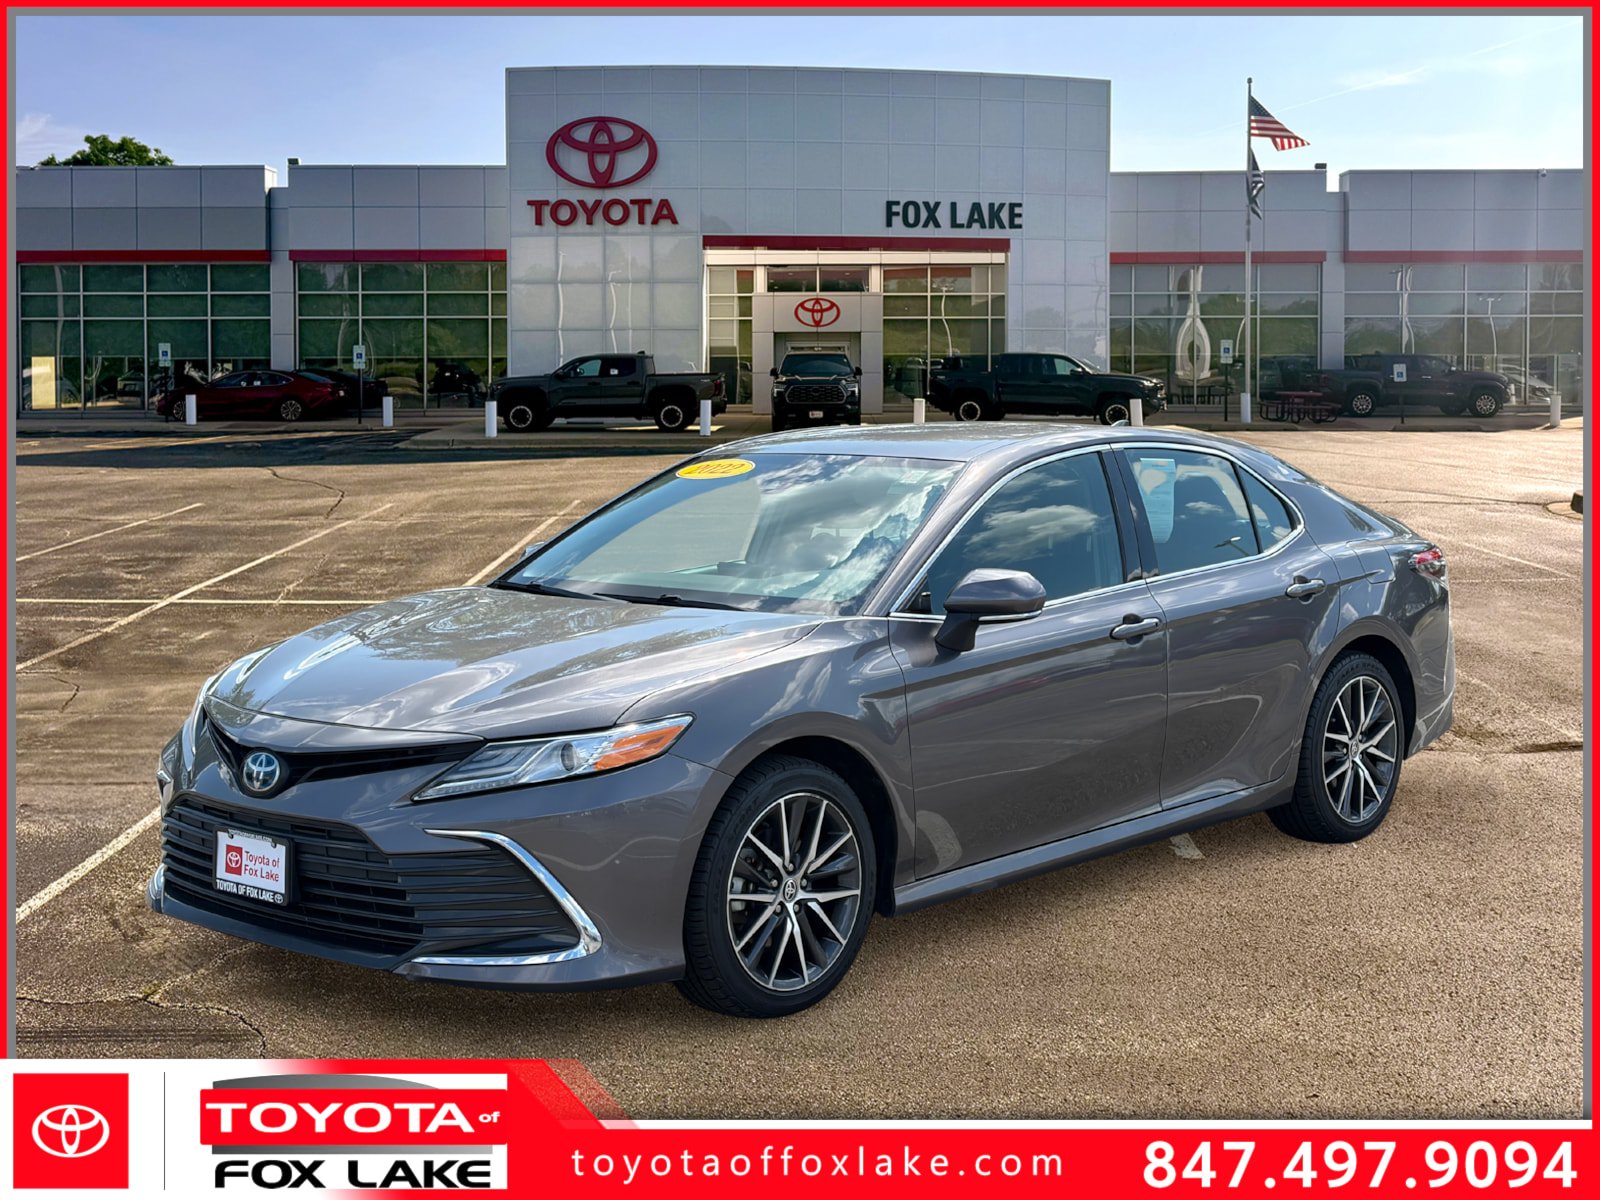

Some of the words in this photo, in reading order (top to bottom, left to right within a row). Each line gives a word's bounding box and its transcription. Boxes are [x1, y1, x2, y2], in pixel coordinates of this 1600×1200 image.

[528, 199, 678, 226] TOYOTA
[885, 201, 942, 229] FOX
[950, 202, 1023, 230] LAKE
[684, 462, 746, 475] 2022
[244, 851, 270, 866] Toyota
[271, 857, 280, 868] of
[244, 864, 258, 877] Fox
[260, 868, 279, 882] Lake
[216, 879, 238, 895] TOYOTA
[238, 885, 246, 896] OF
[246, 886, 258, 899] FOX
[258, 889, 274, 902] LAKE
